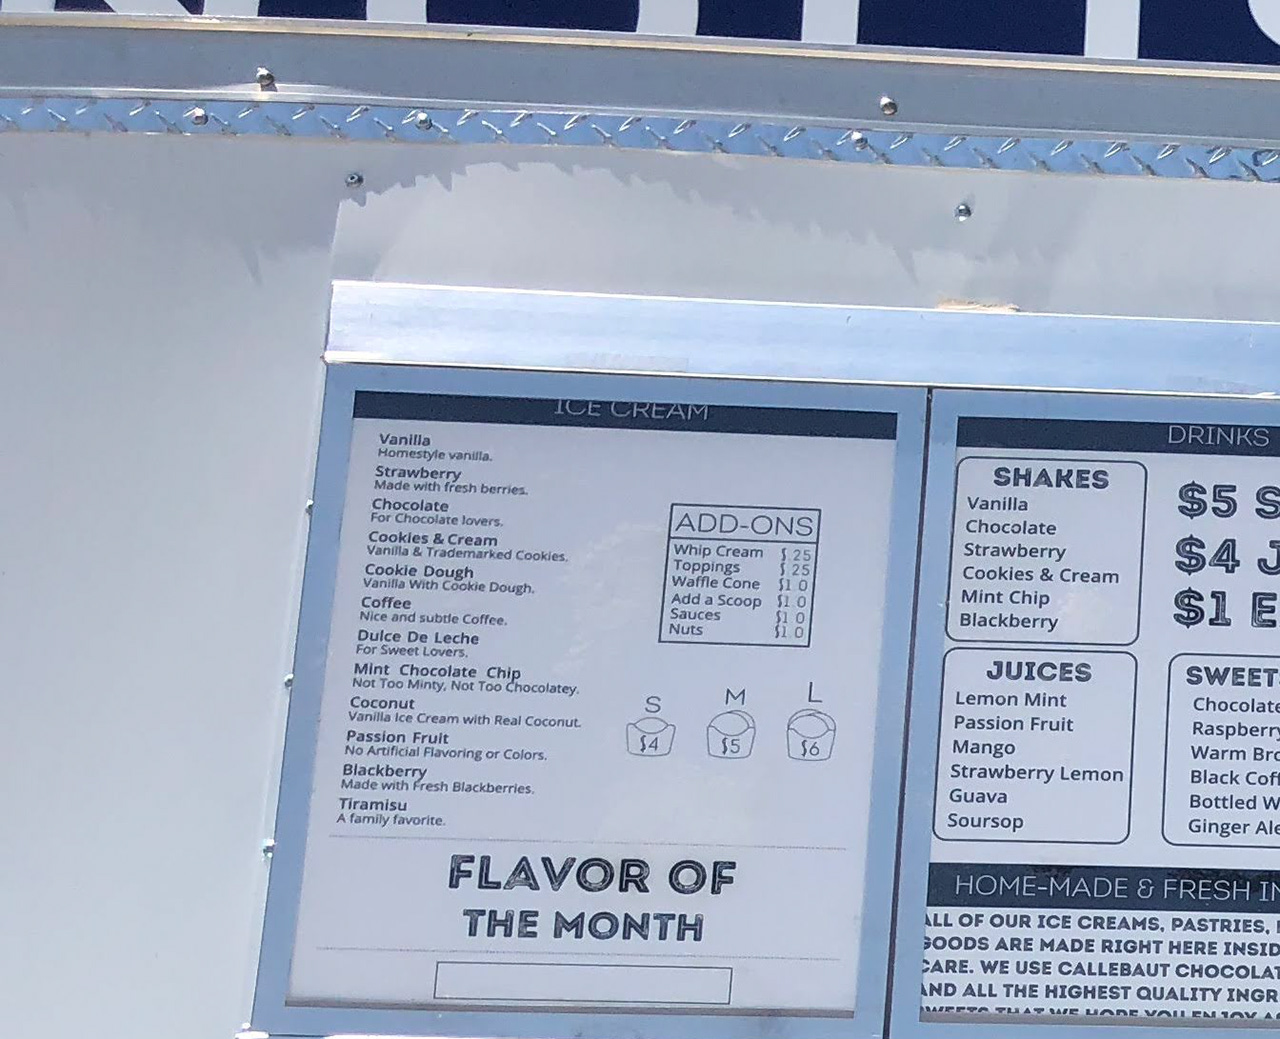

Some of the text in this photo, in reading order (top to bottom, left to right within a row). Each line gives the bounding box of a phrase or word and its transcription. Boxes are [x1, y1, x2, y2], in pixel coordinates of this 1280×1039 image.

[379, 433, 430, 446] Vanilla
[1168, 424, 1269, 446] DRINKS
[377, 447, 492, 461] Homestyle vanilla.
[375, 465, 461, 482] Strawberry
[993, 466, 1108, 489] SHAKES
[373, 479, 528, 495] Made with fresh berries.
[371, 497, 448, 512] Chocolate
[1177, 480, 1237, 519] $5
[674, 512, 812, 536] ADD-ONS
[965, 519, 1056, 535] Chocolate
[368, 530, 497, 546] Cookies & Cream
[673, 543, 763, 558] Whip Cream
[963, 542, 1066, 562] Strawberry
[1174, 533, 1240, 575] $4
[673, 558, 740, 575] Toppings
[361, 596, 411, 609] Coffee
[1173, 586, 1231, 628] $1
[359, 610, 507, 625] Nice and subtle Coffee.
[670, 607, 720, 620] Sauces
[668, 623, 702, 635] Nuts
[986, 660, 1091, 682] JUICES
[725, 688, 745, 705] M
[808, 681, 822, 702] L
[350, 695, 414, 709] Coconut
[644, 695, 661, 713] S
[954, 715, 1073, 731] Passion Fruit
[339, 797, 406, 811] Tiramisu
[949, 788, 1007, 803] Guava
[336, 812, 445, 827] A family favorite.
[1188, 818, 1250, 837] Ginger
[448, 854, 736, 894] FLAVOR OF
[955, 874, 1127, 897] HOME-MADE
[1136, 878, 1154, 898] &
[1163, 878, 1249, 900] FRESH
[462, 908, 703, 941] THE MONTH
[958, 913, 984, 927] OF
[989, 913, 1031, 928] OUR
[1037, 914, 1071, 928] ICE
[1077, 915, 1164, 932] CREAMS,
[1171, 917, 1269, 934] PASTRIES,
